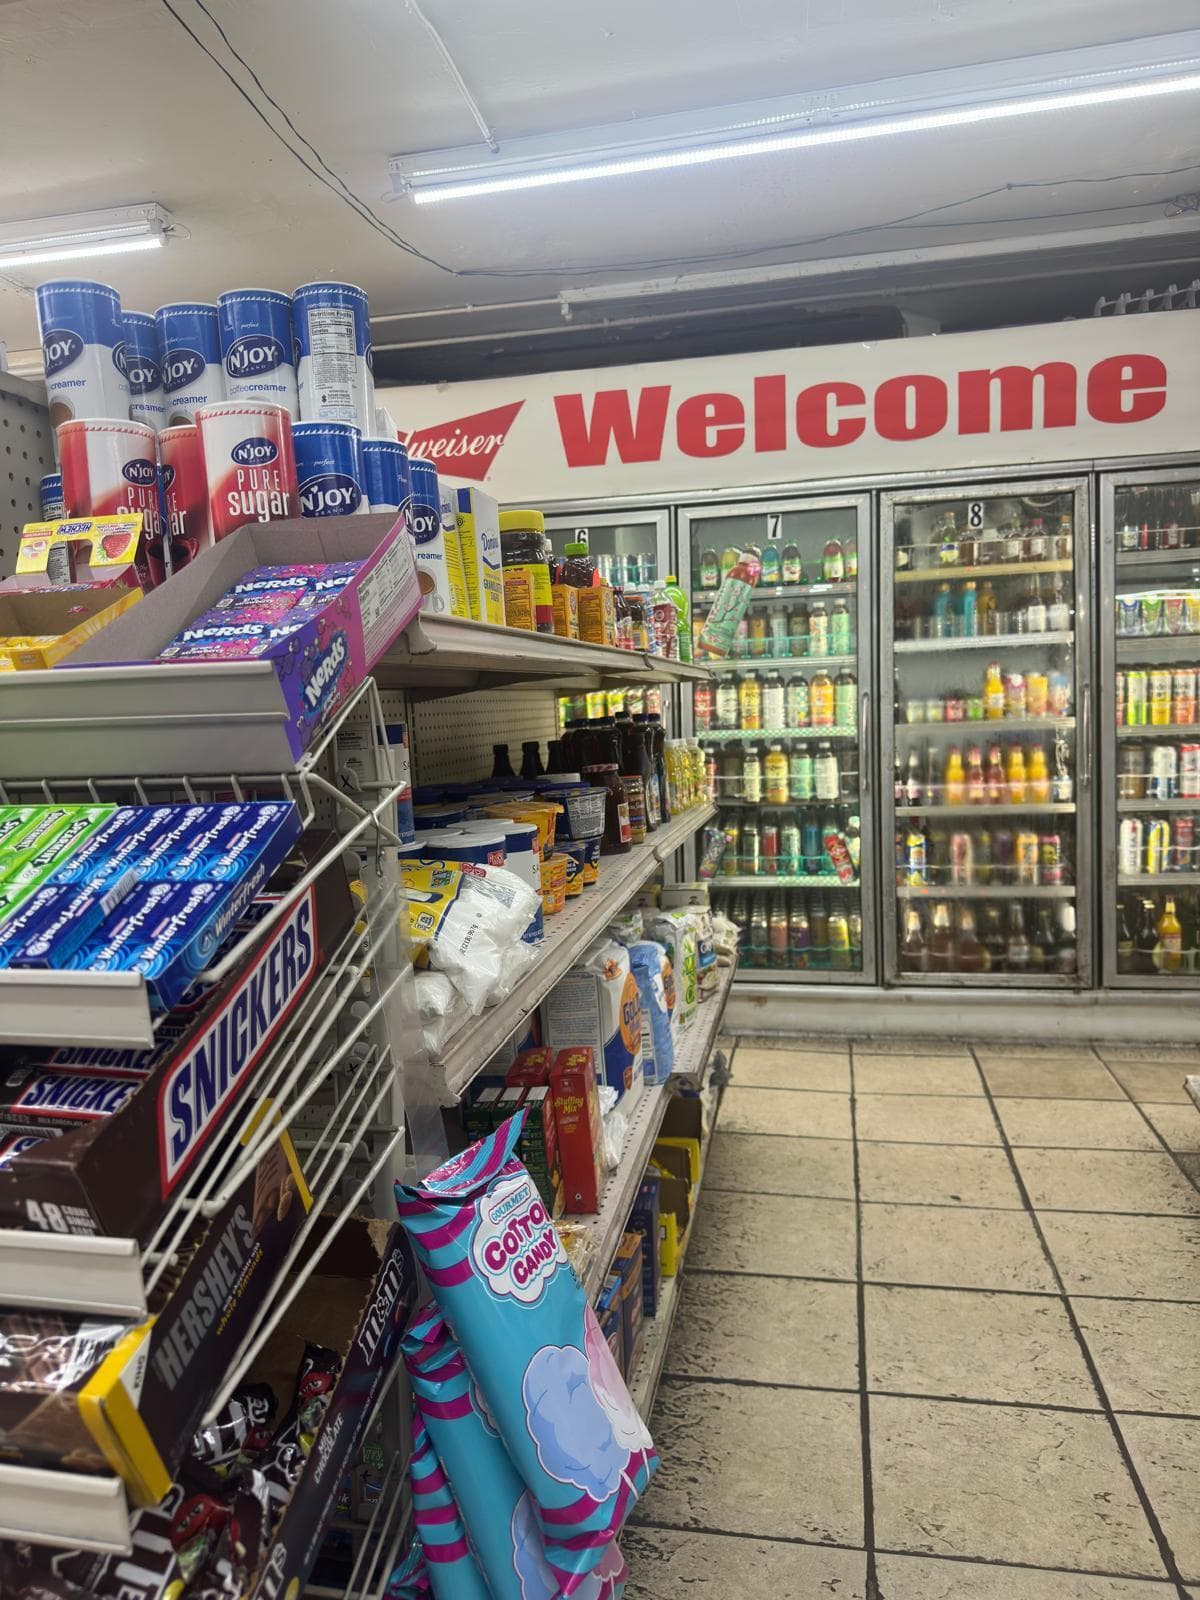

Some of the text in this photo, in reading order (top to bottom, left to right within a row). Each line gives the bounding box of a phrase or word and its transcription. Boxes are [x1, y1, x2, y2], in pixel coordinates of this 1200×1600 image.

[172, 394, 208, 406] creamer
[553, 353, 1168, 468] Welcome
[404, 428, 505, 459] weiser
[237, 469, 281, 491] PURE
[228, 490, 290, 523] sugar
[315, 507, 345, 517] BRAND
[769, 515, 781, 538] 7
[970, 503, 983, 528] 8
[418, 552, 443, 561] reamer
[577, 530, 588, 545] 6
[33, 819, 90, 864] SPEARMINT
[66, 817, 127, 870] Winterfresh
[107, 815, 162, 869] Winterfresh
[140, 815, 195, 868] Winterfresh
[178, 814, 233, 868] Winterfresh
[218, 814, 270, 868] Winterfresh
[0, 898, 46, 946] terfresh
[214, 864, 266, 937] Winterfresh
[98, 894, 162, 960] Winterfresh
[140, 894, 204, 960] Winterfresh
[169, 898, 312, 1167] SNICKERS
[18, 1074, 140, 1113] SNICKE
[554, 1095, 584, 1107] Stuffing
[562, 1105, 577, 1114] Mix
[25, 1198, 69, 1233] 48
[490, 1187, 531, 1222] GOURMET
[512, 1227, 557, 1285] CANDY
[153, 1203, 254, 1392] HERSHEY'S
[215, 1248, 264, 1336] whole almonds
[313, 1412, 345, 1485] CHOCOLATE
[317, 1421, 334, 1455] MILK
